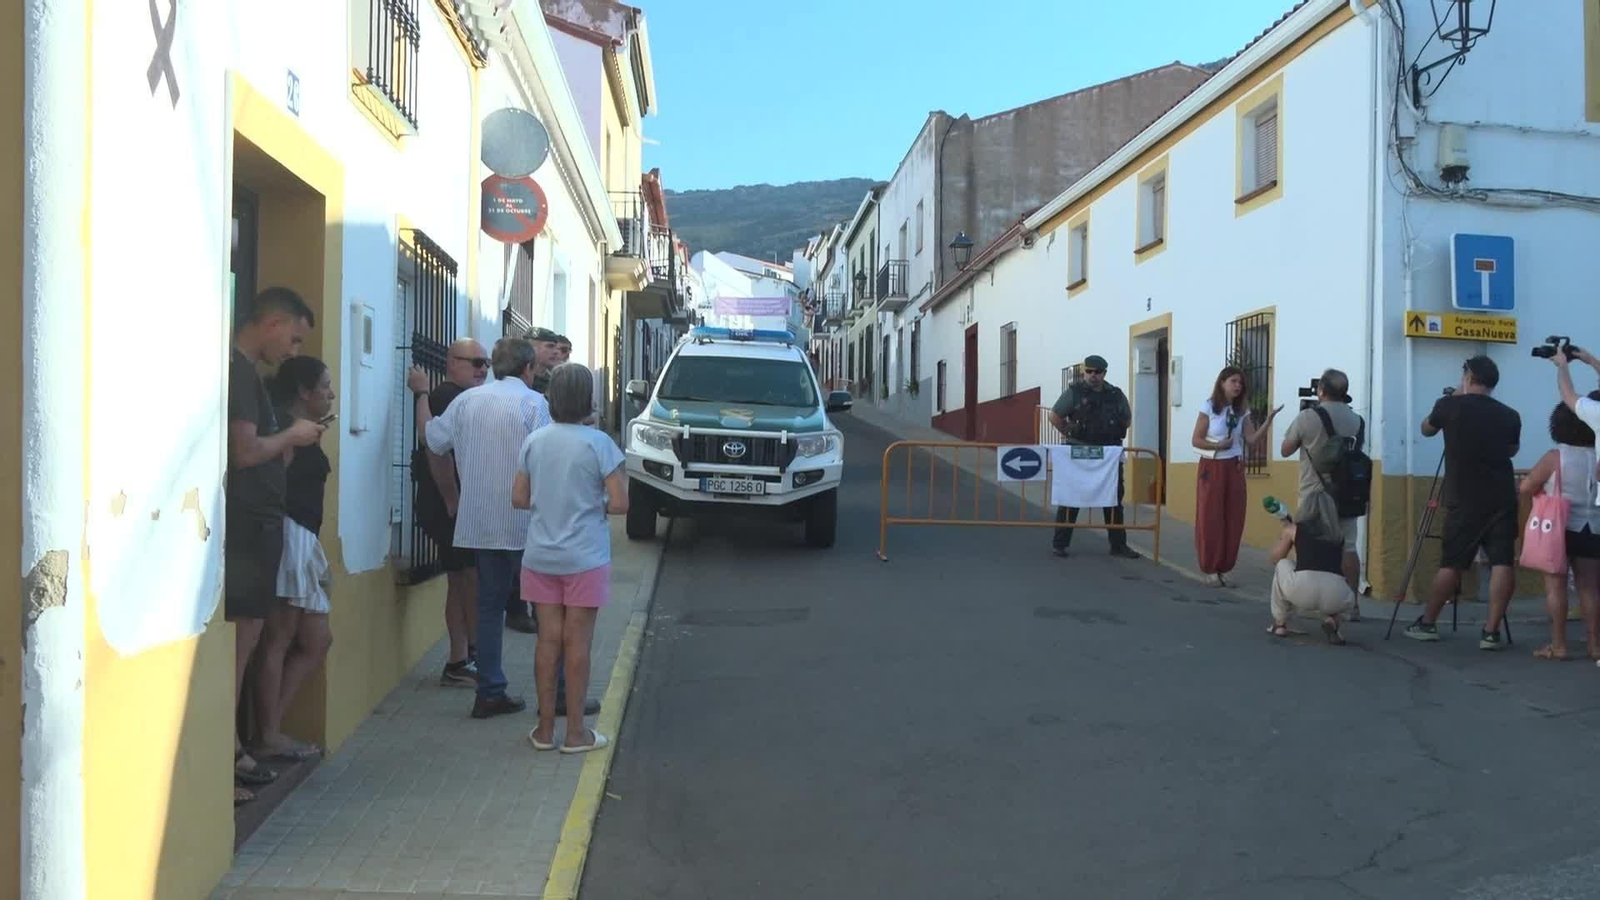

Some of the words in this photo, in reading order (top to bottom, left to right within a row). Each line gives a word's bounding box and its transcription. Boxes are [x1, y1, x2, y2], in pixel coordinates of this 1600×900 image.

[1498, 319, 1516, 327] Rural
[1455, 325, 1516, 340] CasaNueva
[707, 479, 726, 491] PGC
[730, 480, 753, 493] 1256
